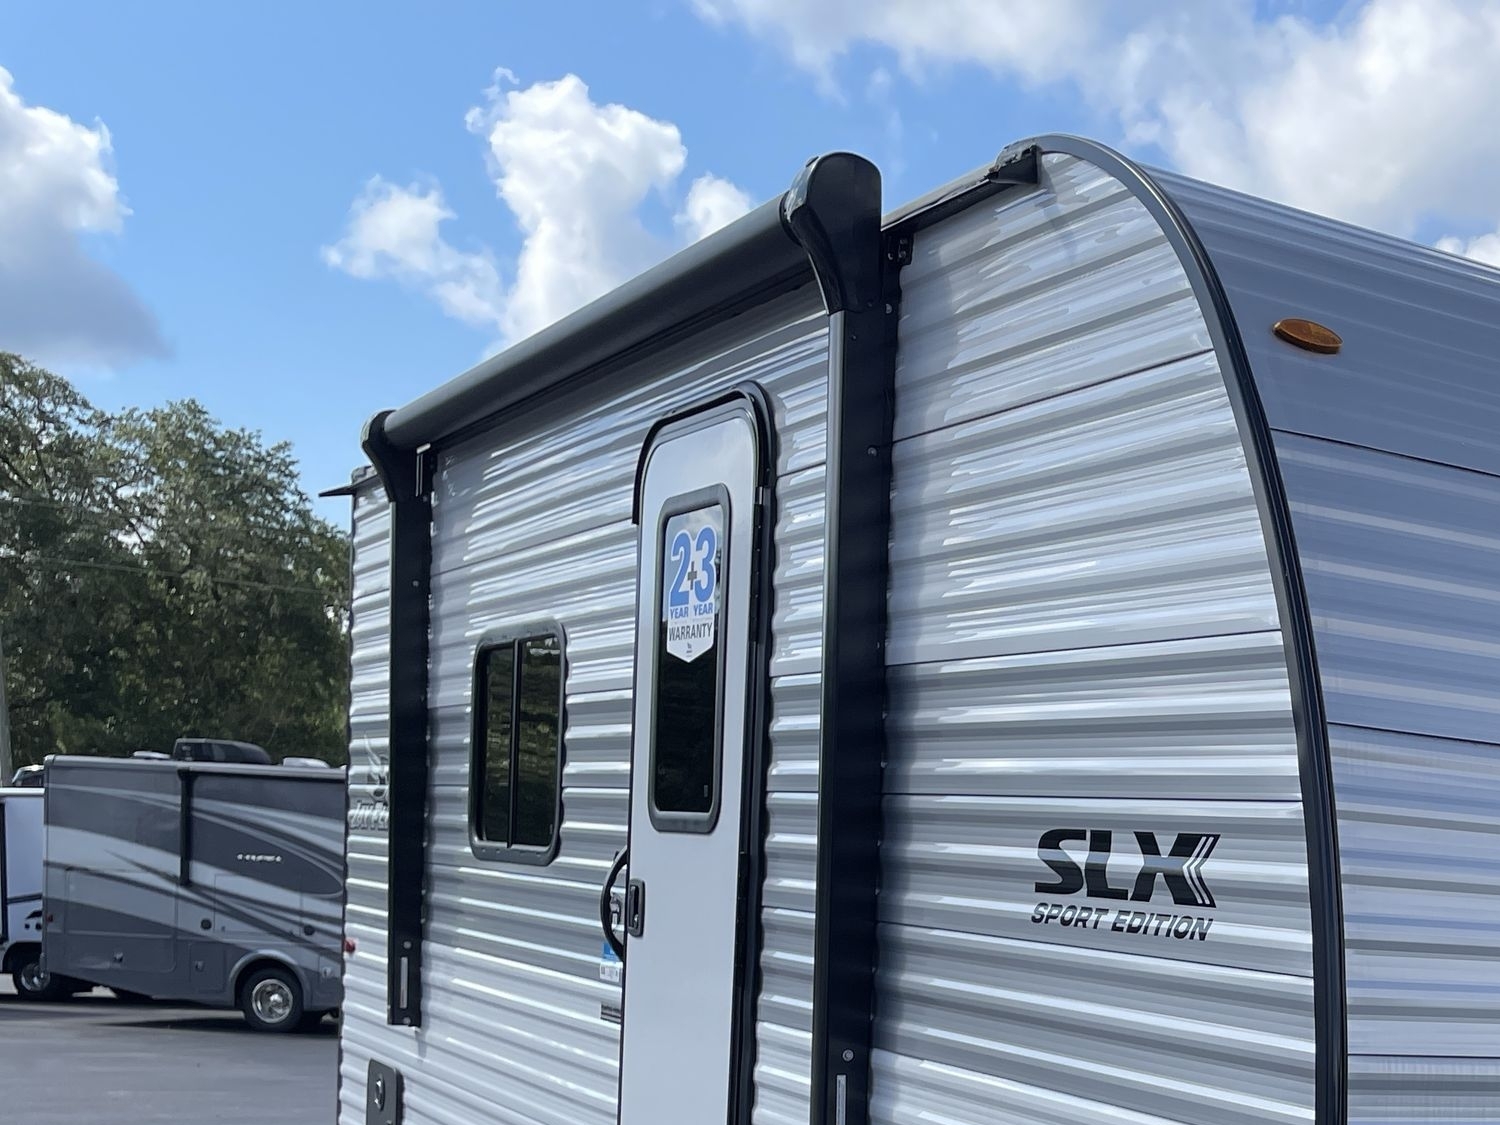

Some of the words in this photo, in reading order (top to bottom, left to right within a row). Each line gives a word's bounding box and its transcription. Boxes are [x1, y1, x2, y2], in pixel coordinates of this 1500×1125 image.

[669, 606, 689, 620] YEAR
[693, 602, 714, 616] YEAR
[668, 622, 713, 642] WARRANTY
[1034, 828, 1222, 908] SLX
[1031, 902, 1109, 930] SPORT
[1111, 910, 1214, 941] EDITION
